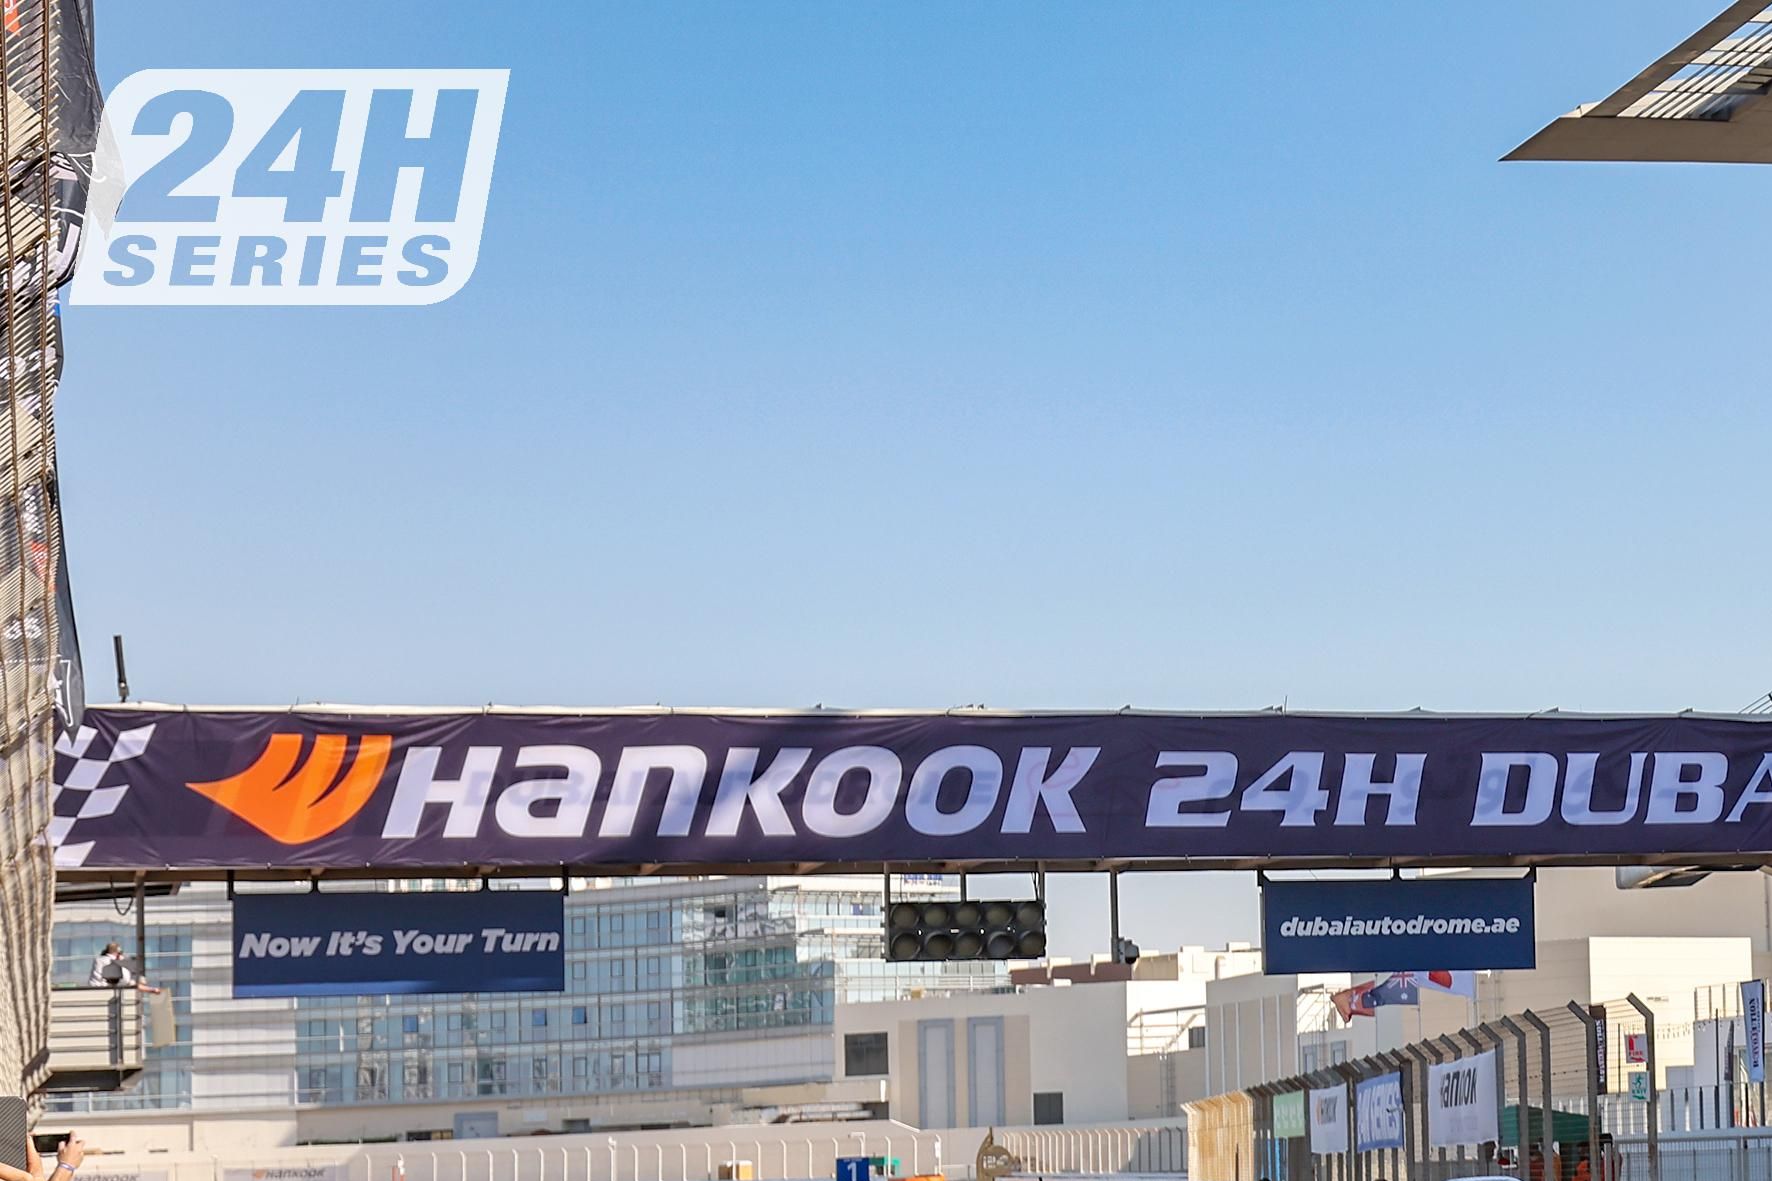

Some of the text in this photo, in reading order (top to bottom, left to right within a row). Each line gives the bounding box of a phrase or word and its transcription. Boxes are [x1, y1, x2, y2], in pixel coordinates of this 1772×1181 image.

[1145, 751, 1428, 828] 24H
[1279, 913, 1520, 937] dubaiautodrome.ae
[239, 932, 319, 959] Now
[392, 929, 474, 957] Your
[480, 927, 559, 953] Turn
[846, 1163, 858, 1181] 1
